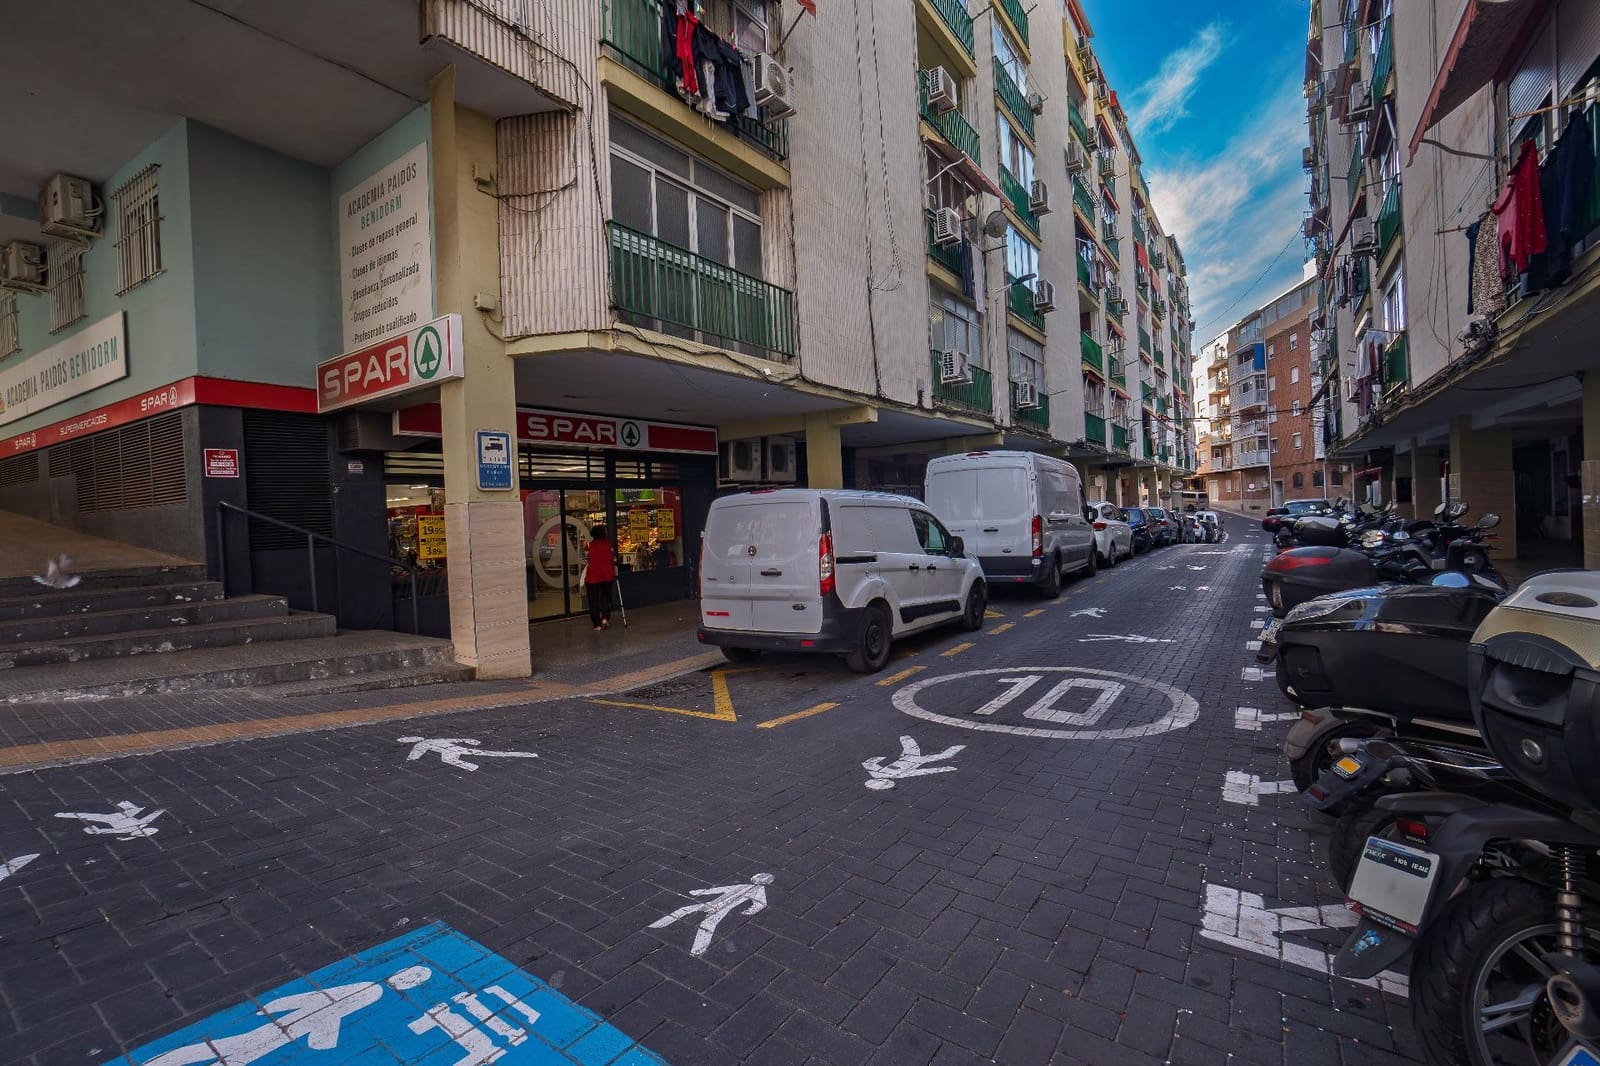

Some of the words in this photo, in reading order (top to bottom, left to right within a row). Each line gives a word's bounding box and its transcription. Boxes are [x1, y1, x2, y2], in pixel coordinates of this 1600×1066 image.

[347, 183, 385, 216] ACADEMIA
[387, 162, 417, 193] PAIDÓS
[361, 194, 402, 230] BENIDORM
[368, 237, 375, 249] de
[375, 227, 394, 244] repaso
[395, 212, 418, 236] general
[369, 260, 375, 271] de
[376, 249, 399, 267] idiomas
[352, 281, 379, 301] Enseñanza
[380, 261, 419, 289] personalizada
[353, 308, 371, 323] Grupos
[371, 296, 399, 315] reducidos
[354, 324, 385, 344] Profesorado
[386, 312, 417, 332] cualificado
[6, 375, 39, 409] ACADEMIA
[40, 358, 68, 392] PAIDÓS
[69, 335, 118, 379] BENIDORM
[324, 345, 407, 399] SPAR
[140, 392, 168, 412] SPAR
[59, 413, 108, 436] SUPERMERCADOS
[527, 416, 616, 443] SPAR
[14, 436, 32, 450] SPAR
[972, 675, 1127, 726] 10
